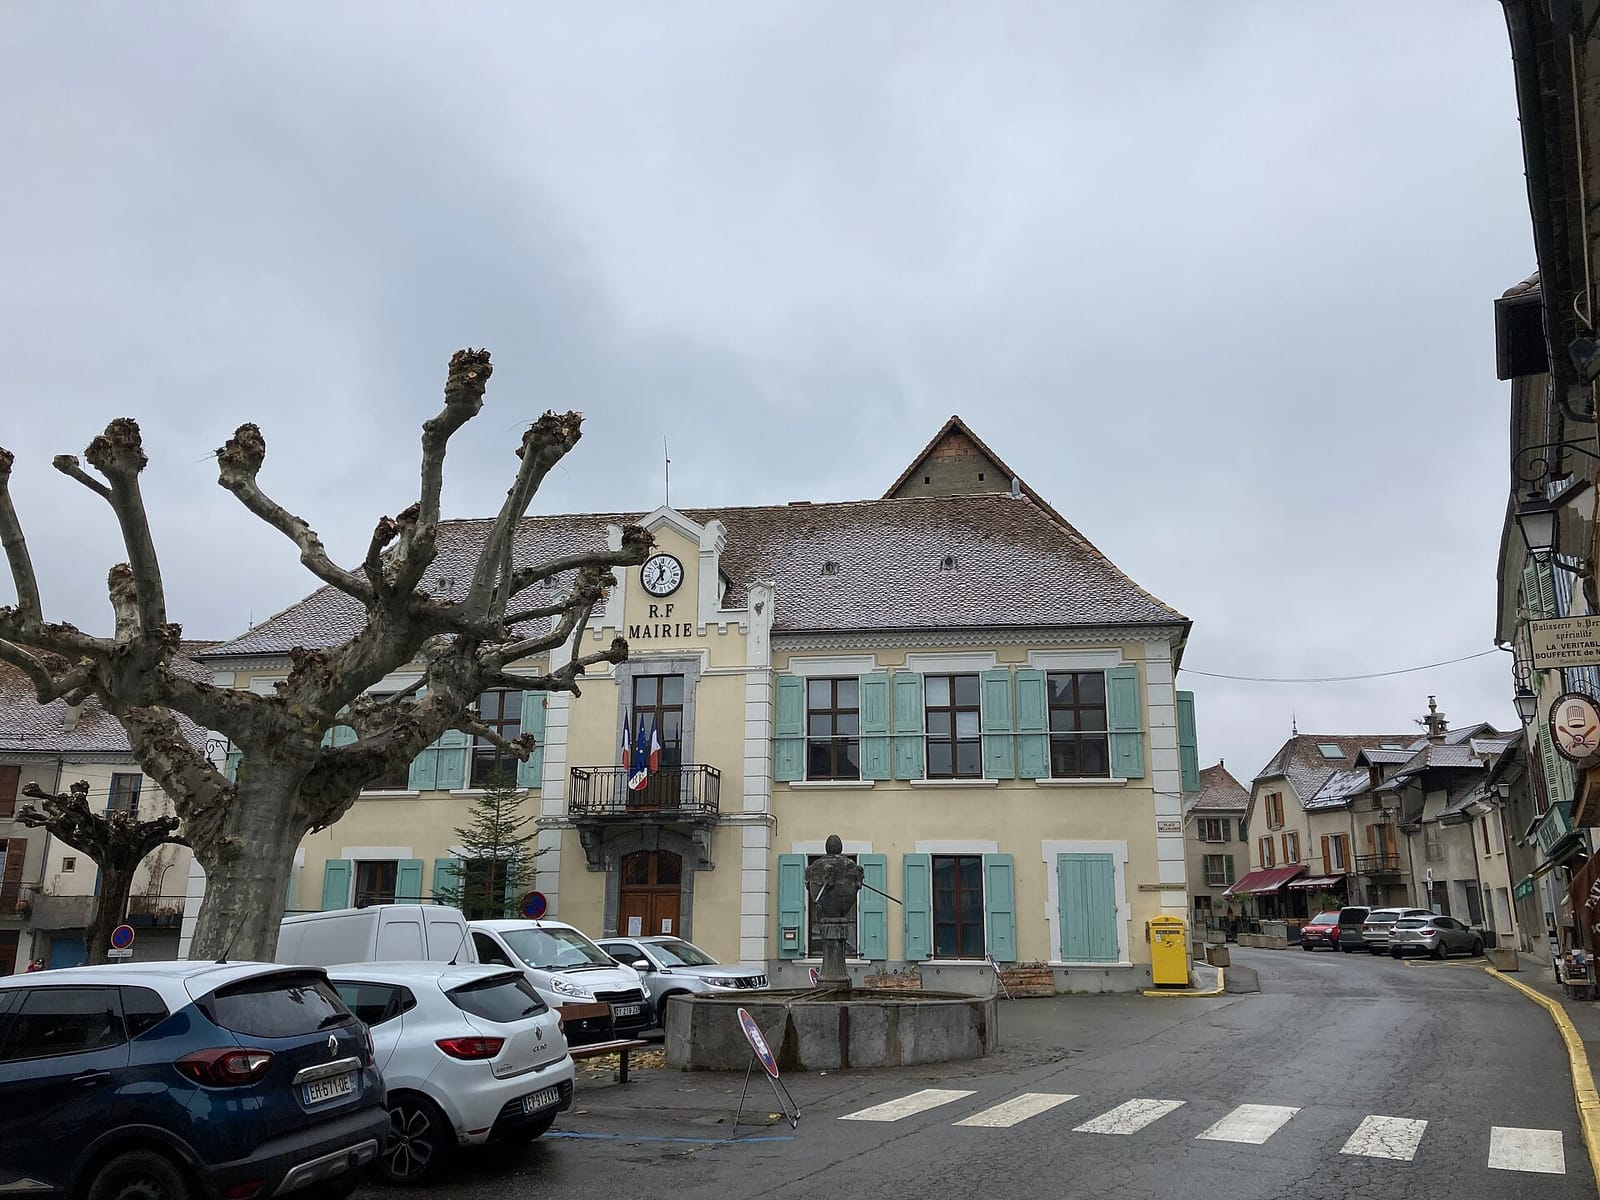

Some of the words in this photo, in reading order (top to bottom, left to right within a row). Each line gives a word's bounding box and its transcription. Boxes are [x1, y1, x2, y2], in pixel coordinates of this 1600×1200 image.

[649, 604, 674, 618] R.F
[629, 623, 692, 638] MAIRIE
[1535, 651, 1582, 659] BOUFFETTE
[1584, 878, 1600, 910] PAT
